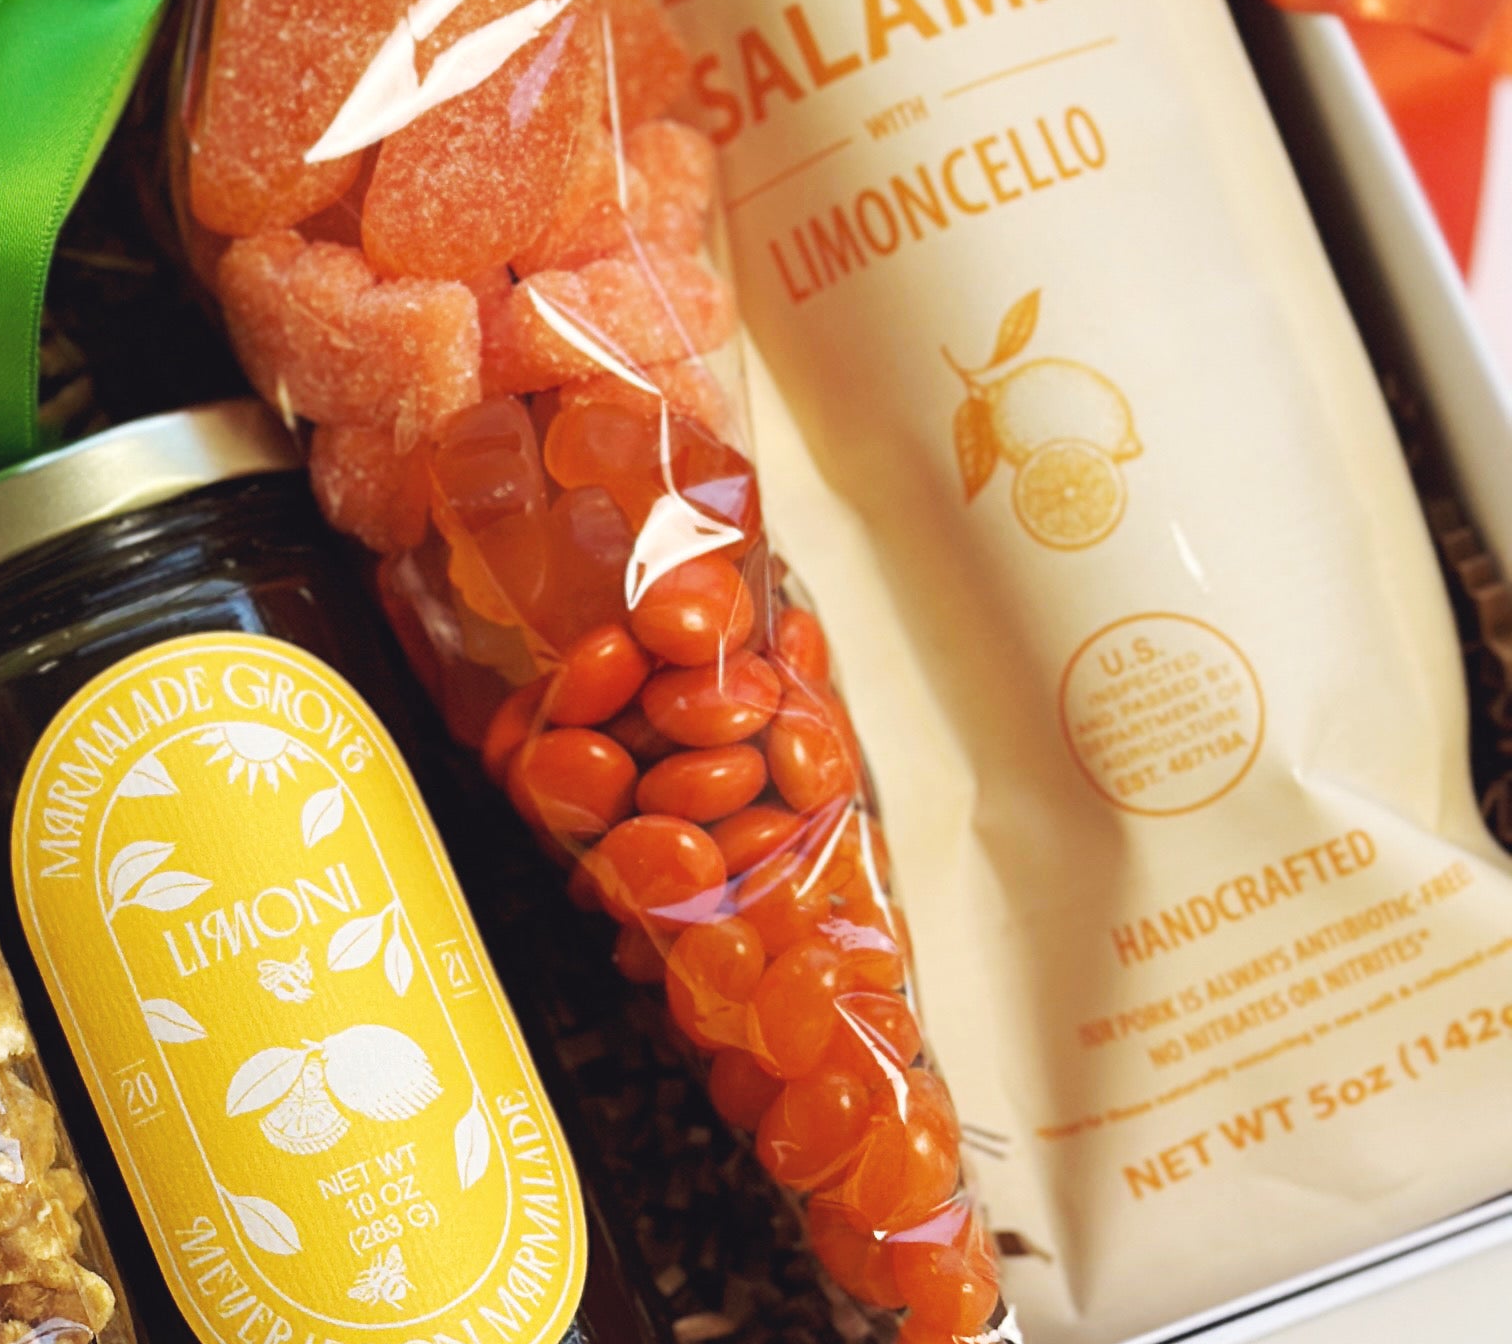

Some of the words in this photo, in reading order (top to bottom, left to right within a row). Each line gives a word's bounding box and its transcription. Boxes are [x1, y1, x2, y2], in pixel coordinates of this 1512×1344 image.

[863, 92, 931, 142] WITH
[767, 102, 1111, 308] LIMONCELLO
[1097, 636, 1167, 678] U.S.
[39, 665, 214, 882] MARMALADE
[161, 862, 365, 979] LIMONI
[1110, 827, 1378, 969] HANDCRAFTED
[439, 948, 473, 991] 21
[1205, 945, 1292, 1002] ALWAYS
[1147, 1038, 1185, 1071] NO
[1184, 992, 1289, 1055] NITRATES
[1289, 975, 1324, 1008] OR
[119, 1070, 159, 1118] 20
[1121, 1130, 1214, 1202] NET
[1215, 1095, 1296, 1153] WT
[1307, 1063, 1394, 1122] 5oz
[316, 1160, 371, 1203] NET
[375, 1141, 420, 1175] WT
[345, 1194, 376, 1222] 10
[379, 1174, 423, 1206] OZ
[347, 1217, 406, 1258] (283
[406, 1199, 441, 1235] G)
[481, 1088, 564, 1344] MARMALADE
